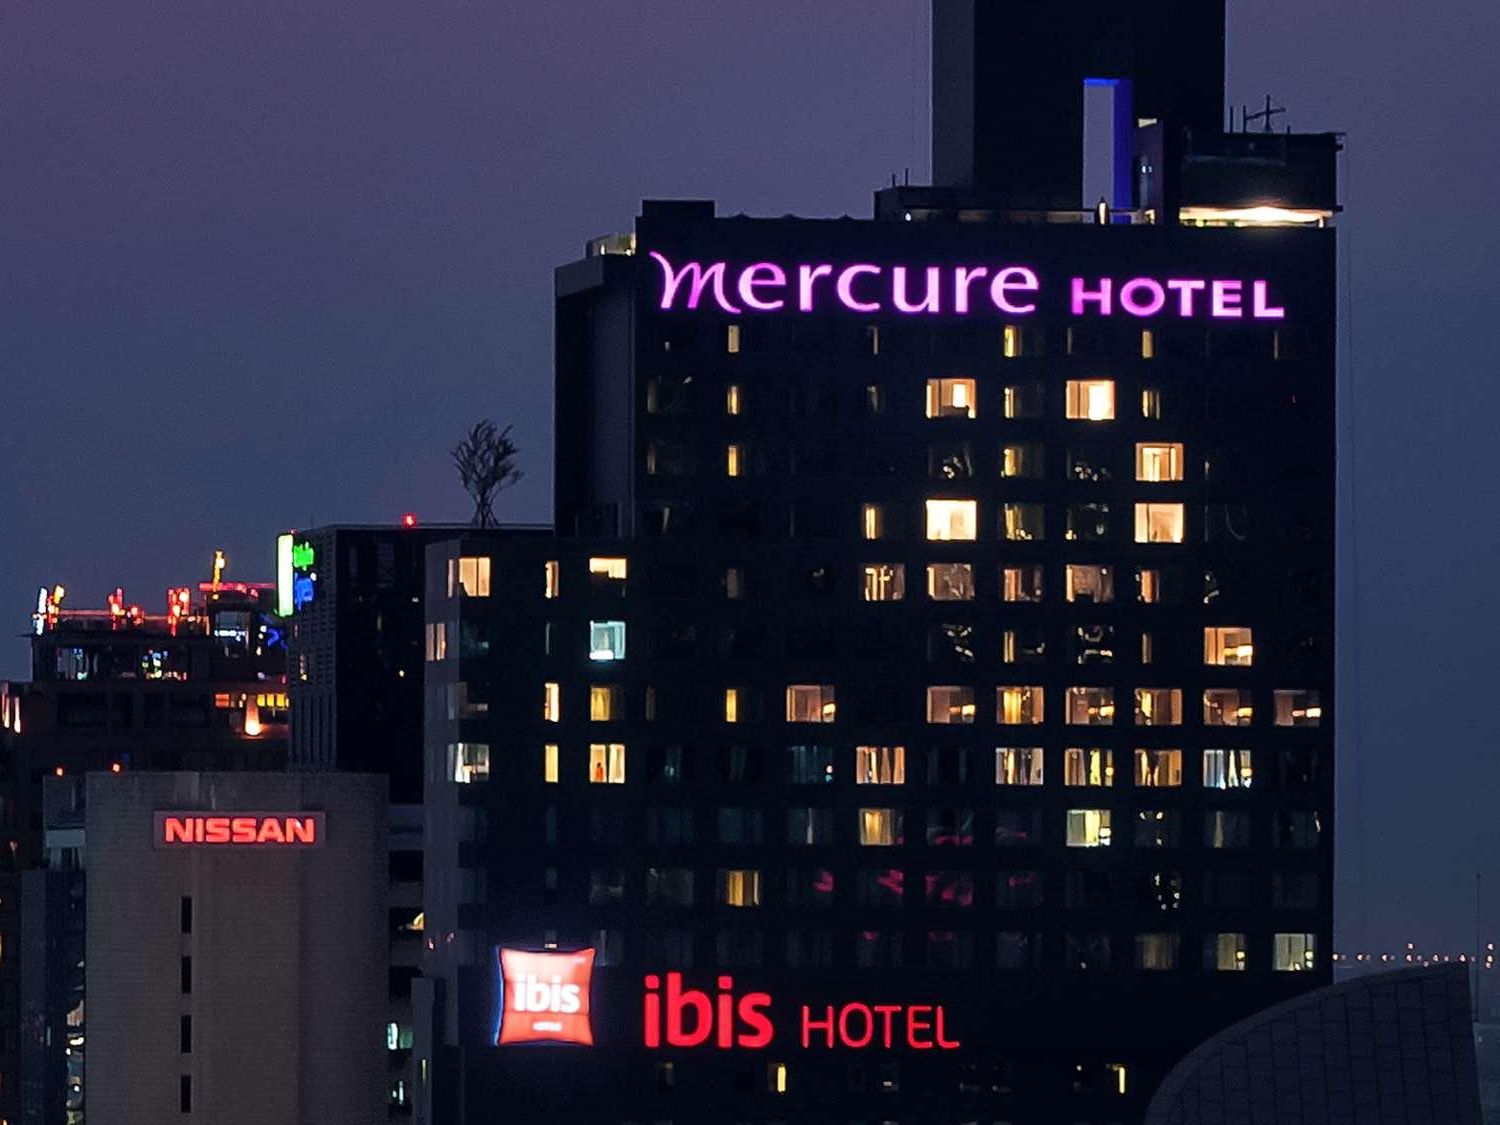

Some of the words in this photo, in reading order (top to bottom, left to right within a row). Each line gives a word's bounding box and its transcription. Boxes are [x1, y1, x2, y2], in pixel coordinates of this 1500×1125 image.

[649, 251, 1040, 314] mercure
[1071, 277, 1285, 318] HOTEL
[164, 817, 315, 843] NISSAN
[513, 974, 581, 1013] ibis
[643, 971, 774, 1049] ibis
[802, 1002, 961, 1049] HOTEL
